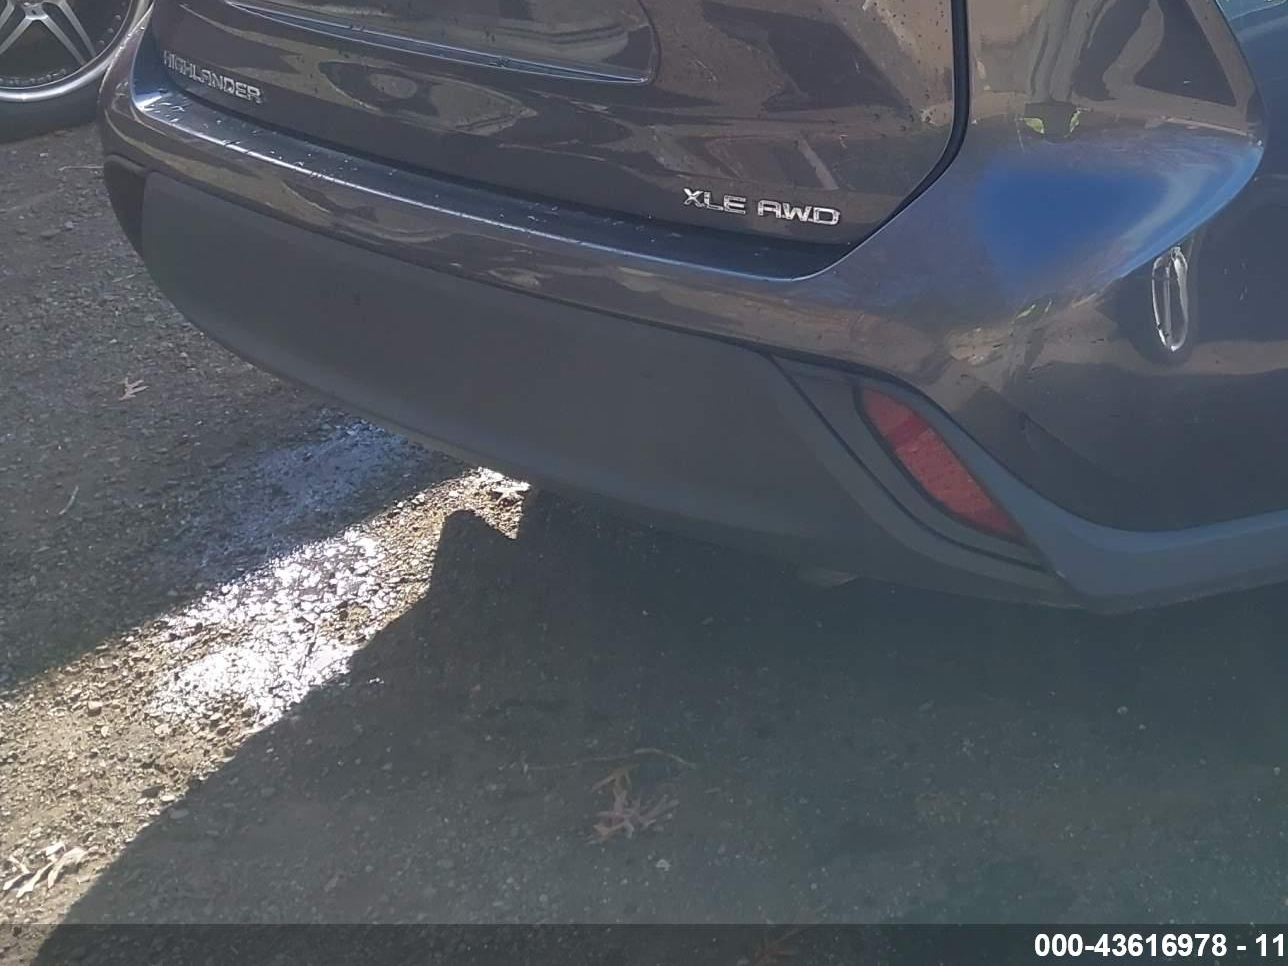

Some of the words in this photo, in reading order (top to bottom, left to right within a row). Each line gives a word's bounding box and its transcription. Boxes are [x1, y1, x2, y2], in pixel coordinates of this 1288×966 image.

[163, 50, 263, 104] HIGHLANDER
[683, 187, 747, 215] XLE
[757, 199, 841, 225] AWD
